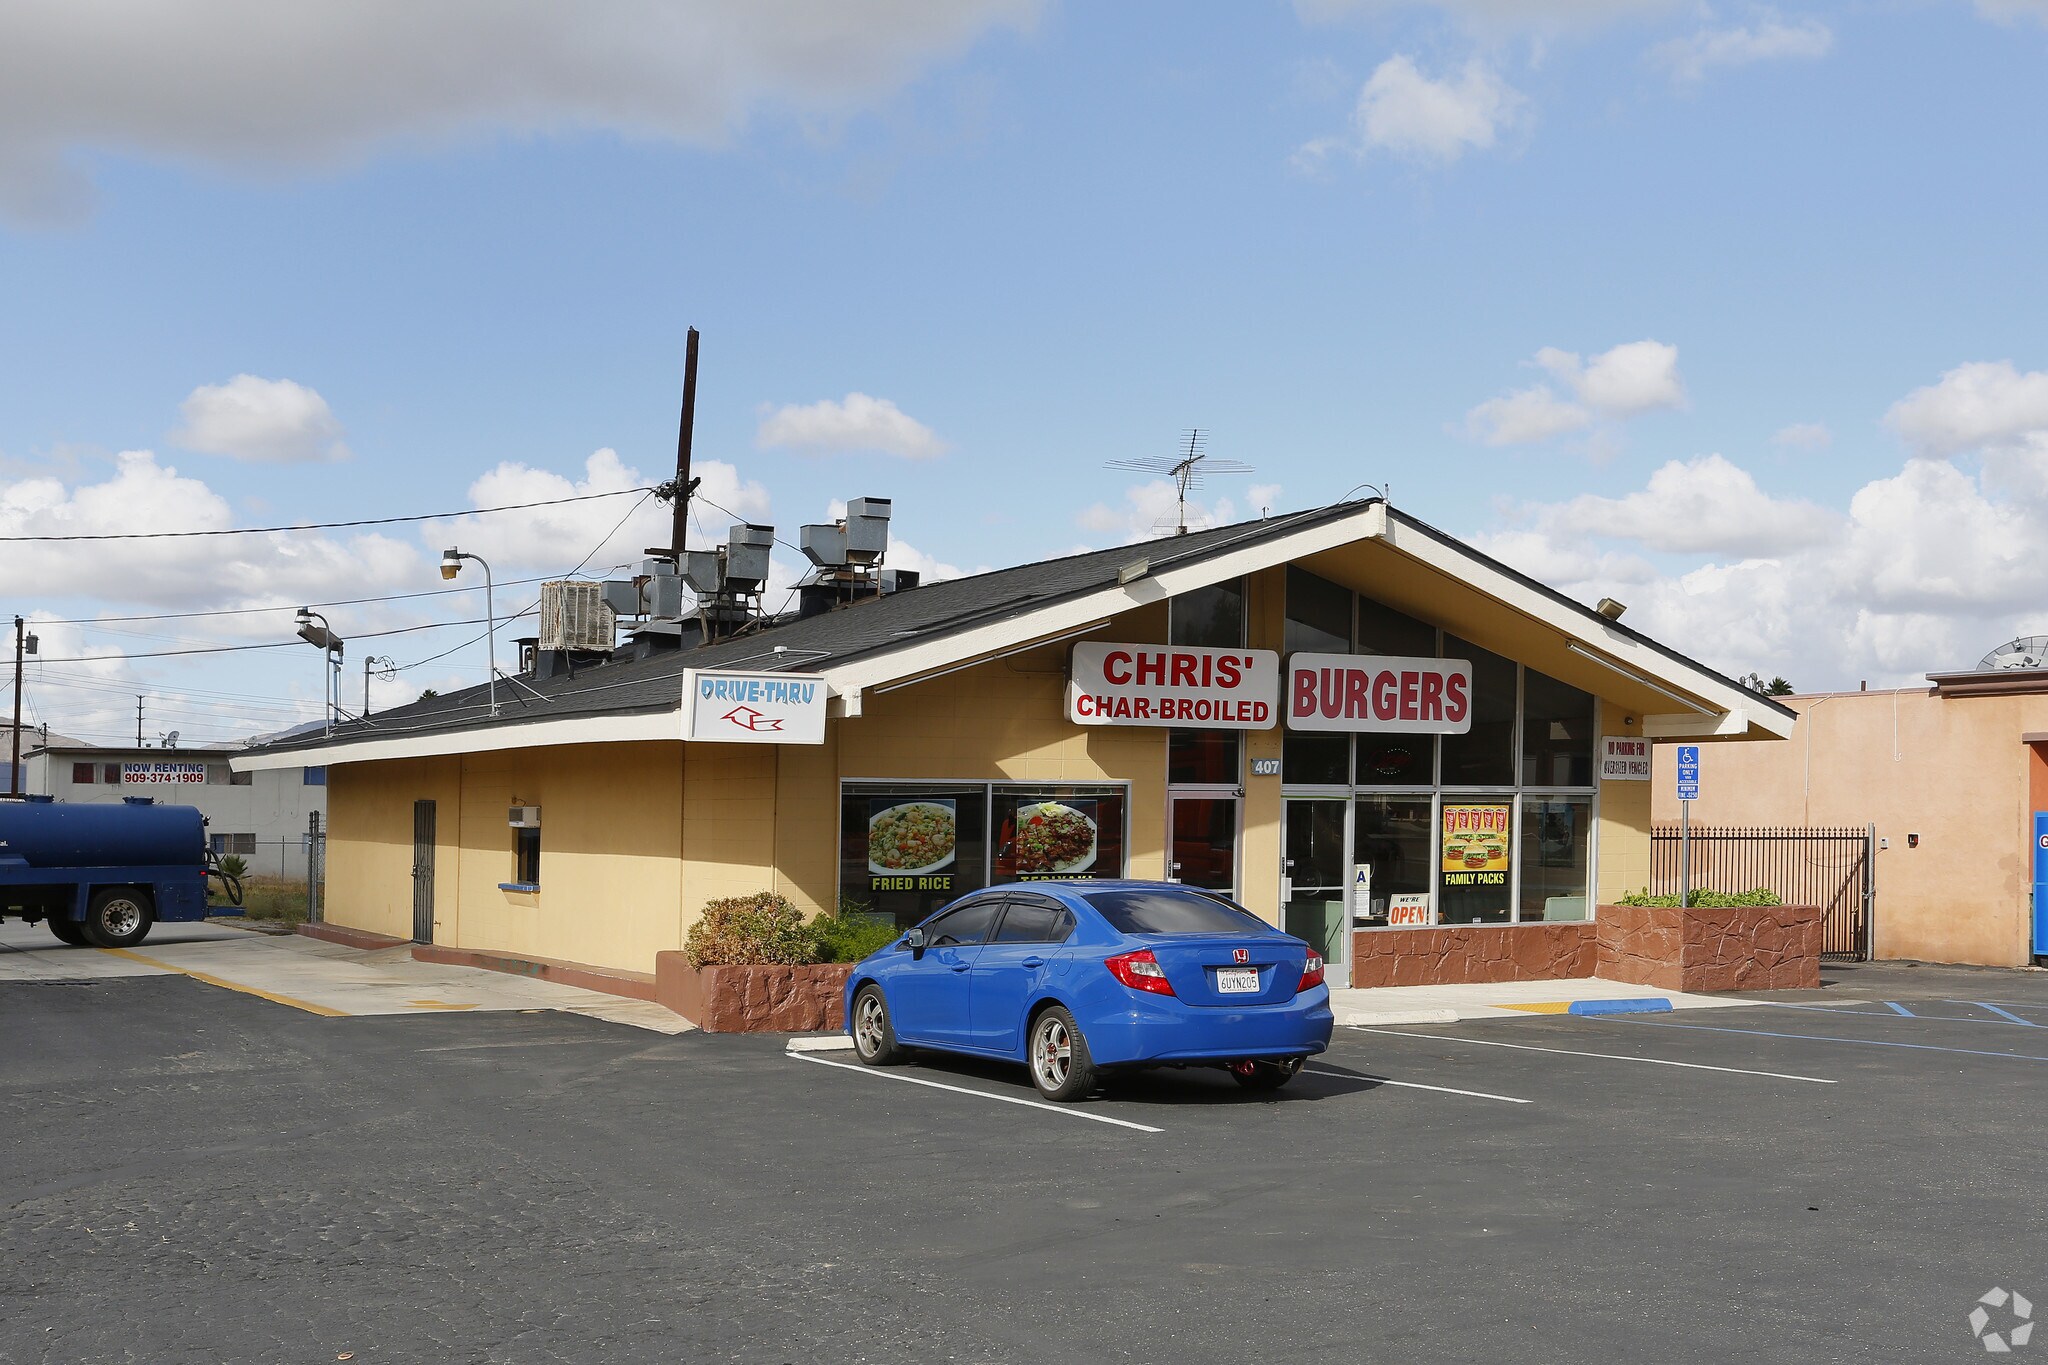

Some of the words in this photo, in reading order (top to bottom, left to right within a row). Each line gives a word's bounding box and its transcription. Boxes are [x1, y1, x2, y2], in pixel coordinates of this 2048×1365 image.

[1103, 651, 1254, 689] CHRIS'
[701, 680, 815, 706] DRIVE-THRU
[1293, 668, 1468, 723] BURGERS
[1077, 694, 1270, 722] CHAR-BROILED
[1616, 741, 1636, 756] PARKING
[124, 763, 151, 773] NOW
[155, 763, 204, 773] RENTING
[1255, 760, 1280, 775] 407
[872, 876, 914, 891] FRIED
[918, 876, 951, 890] RICE
[1356, 870, 1367, 883] A
[1445, 872, 1476, 886] FAMILY
[1478, 872, 1505, 885] PACKS
[1390, 905, 1426, 925] OPEN
[1221, 976, 1257, 989] 6UYN205
